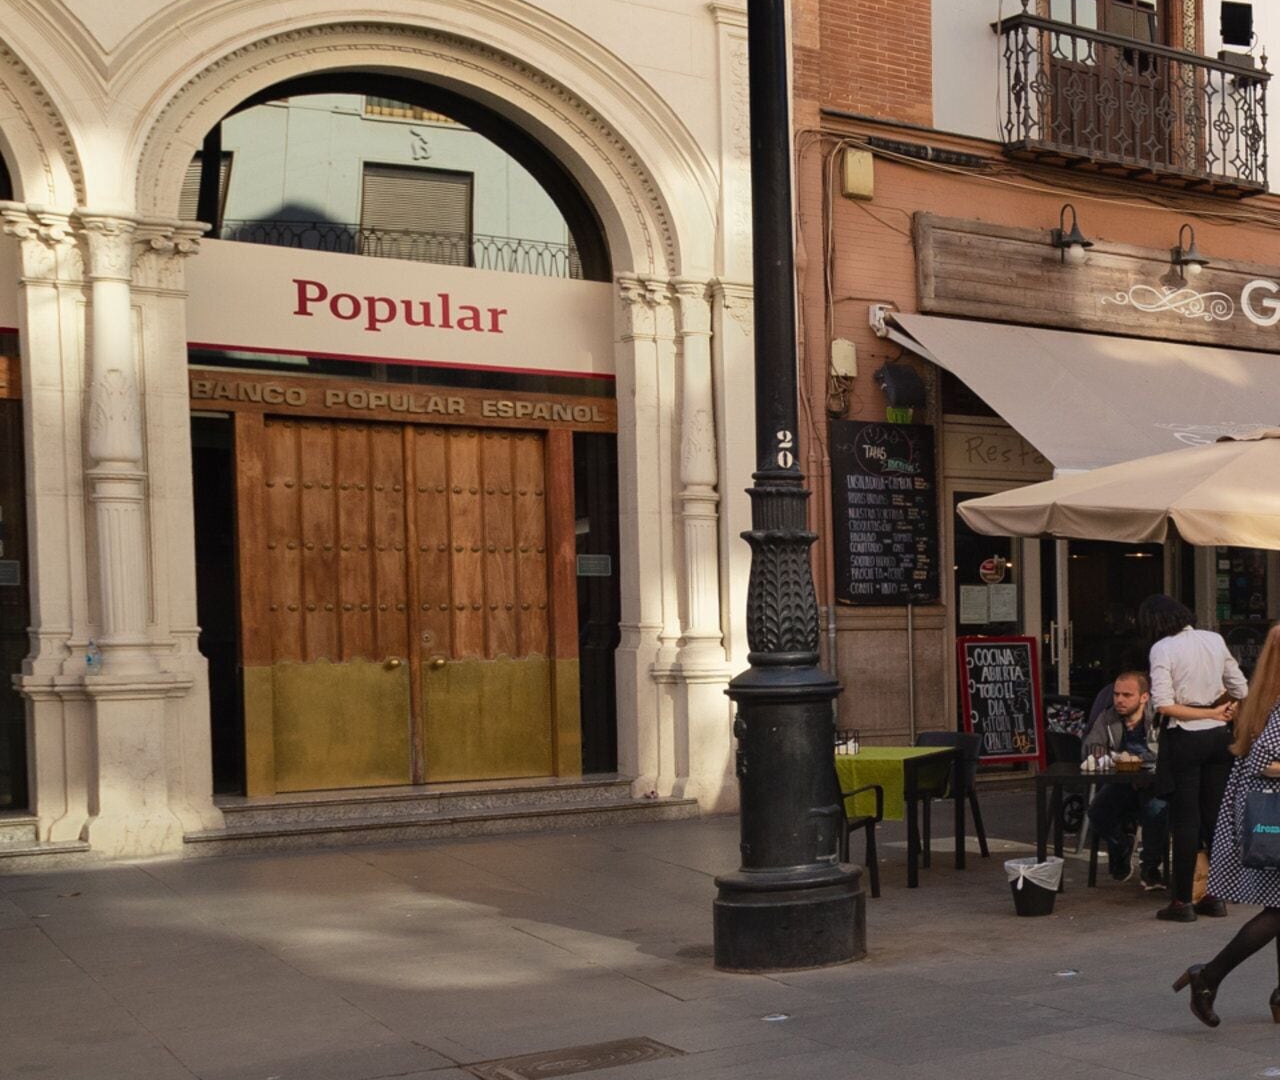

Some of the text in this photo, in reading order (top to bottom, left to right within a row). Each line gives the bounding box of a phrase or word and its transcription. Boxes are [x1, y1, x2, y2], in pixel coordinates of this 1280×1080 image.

[292, 278, 508, 333] Popular
[191, 378, 308, 407] BANCO
[325, 389, 466, 416] POPULAR
[974, 647, 1015, 666] COCINA
[981, 666, 1025, 682] ABIERTA
[976, 683, 1004, 699] TODO
